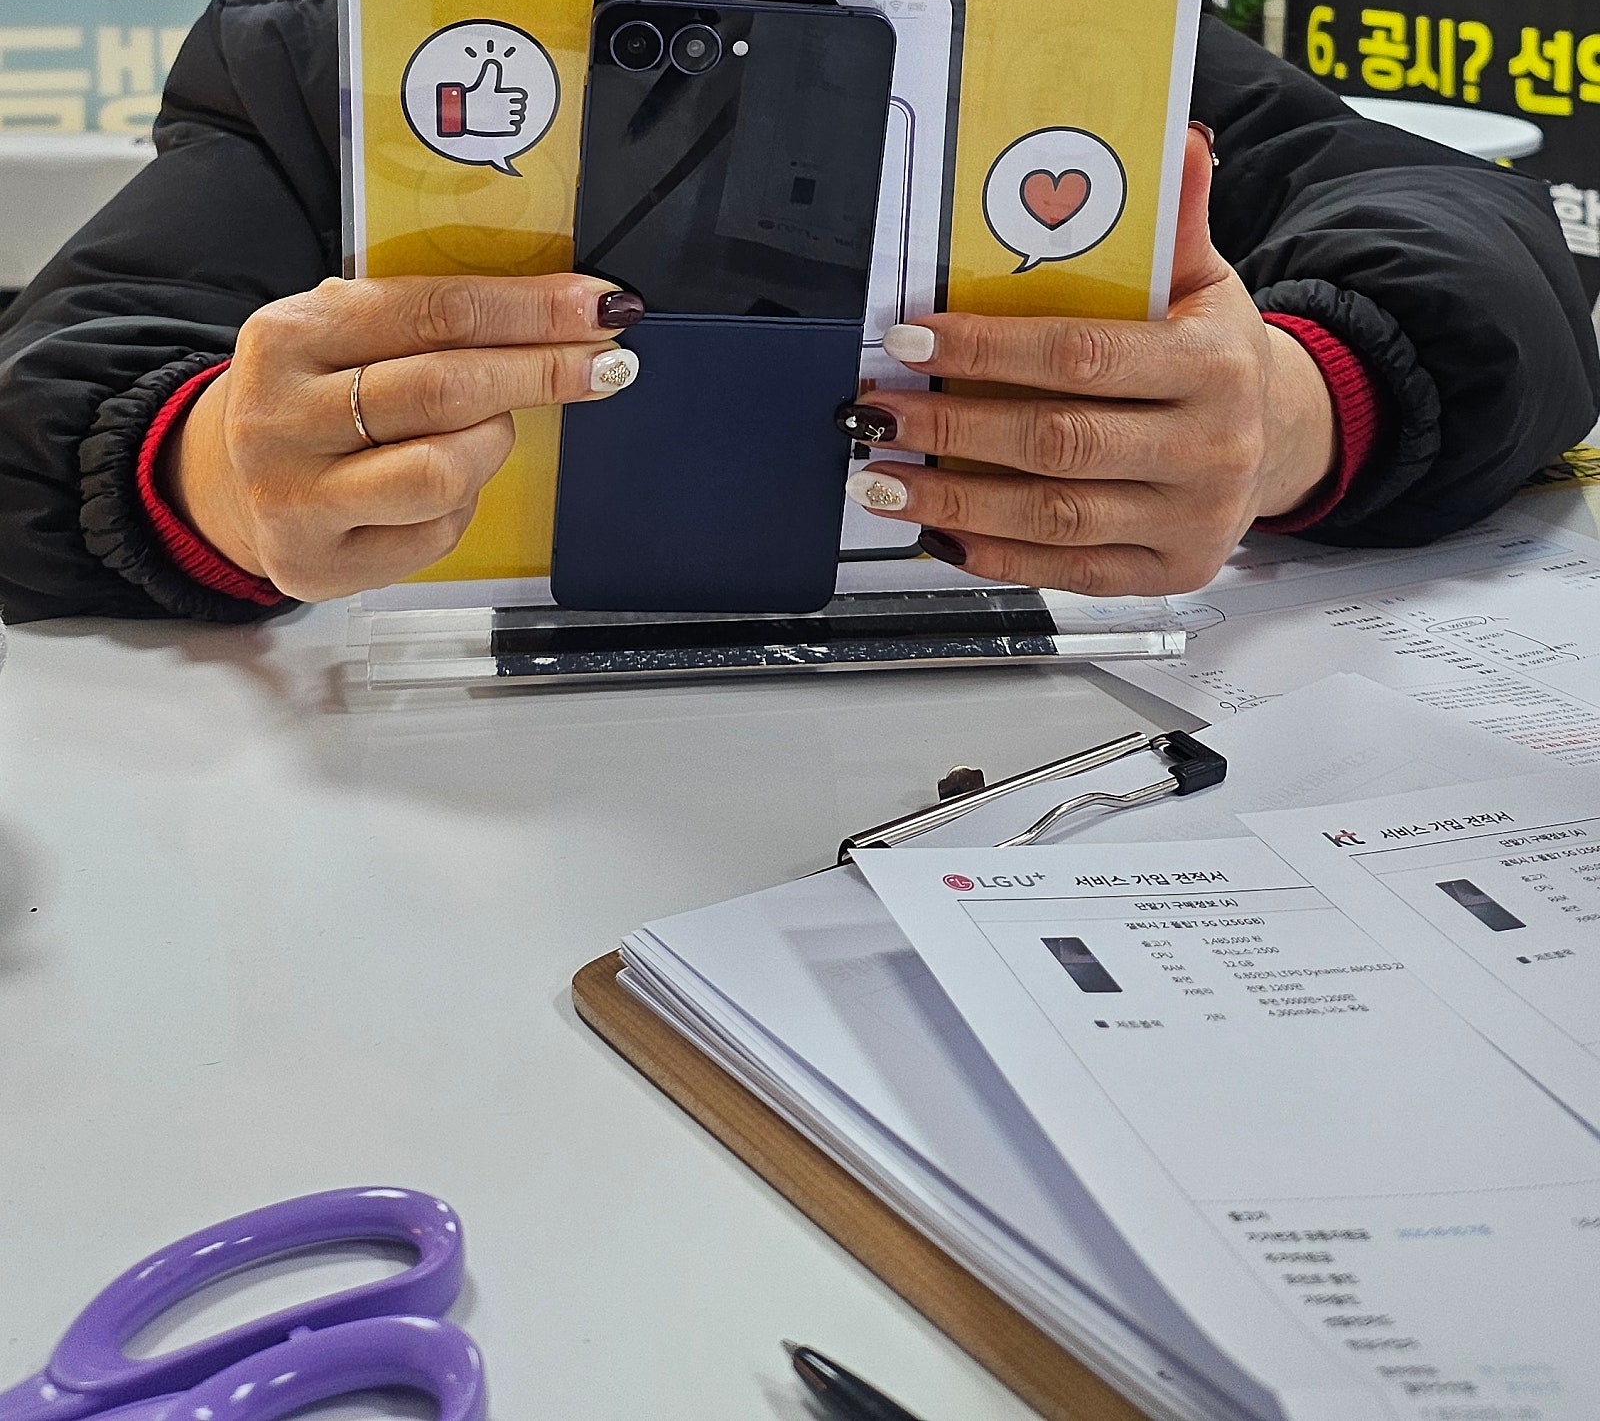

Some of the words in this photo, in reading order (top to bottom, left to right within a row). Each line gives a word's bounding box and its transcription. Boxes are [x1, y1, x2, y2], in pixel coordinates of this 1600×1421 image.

[1307, 5, 1348, 79] 6.
[1358, 9, 1493, 103] 공시?
[1322, 830, 1366, 847] kt
[1381, 825, 1431, 839] 서비스
[1428, 818, 1465, 832] 가입
[1463, 810, 1515, 826] 견적서
[1075, 874, 1130, 887] 서비스
[1131, 873, 1170, 885] 가입
[1171, 870, 1229, 885] 견적서
[1134, 901, 1171, 910] 단말기
[1172, 900, 1218, 909] 구매정보
[1302, 967, 1350, 978] Dynamic
